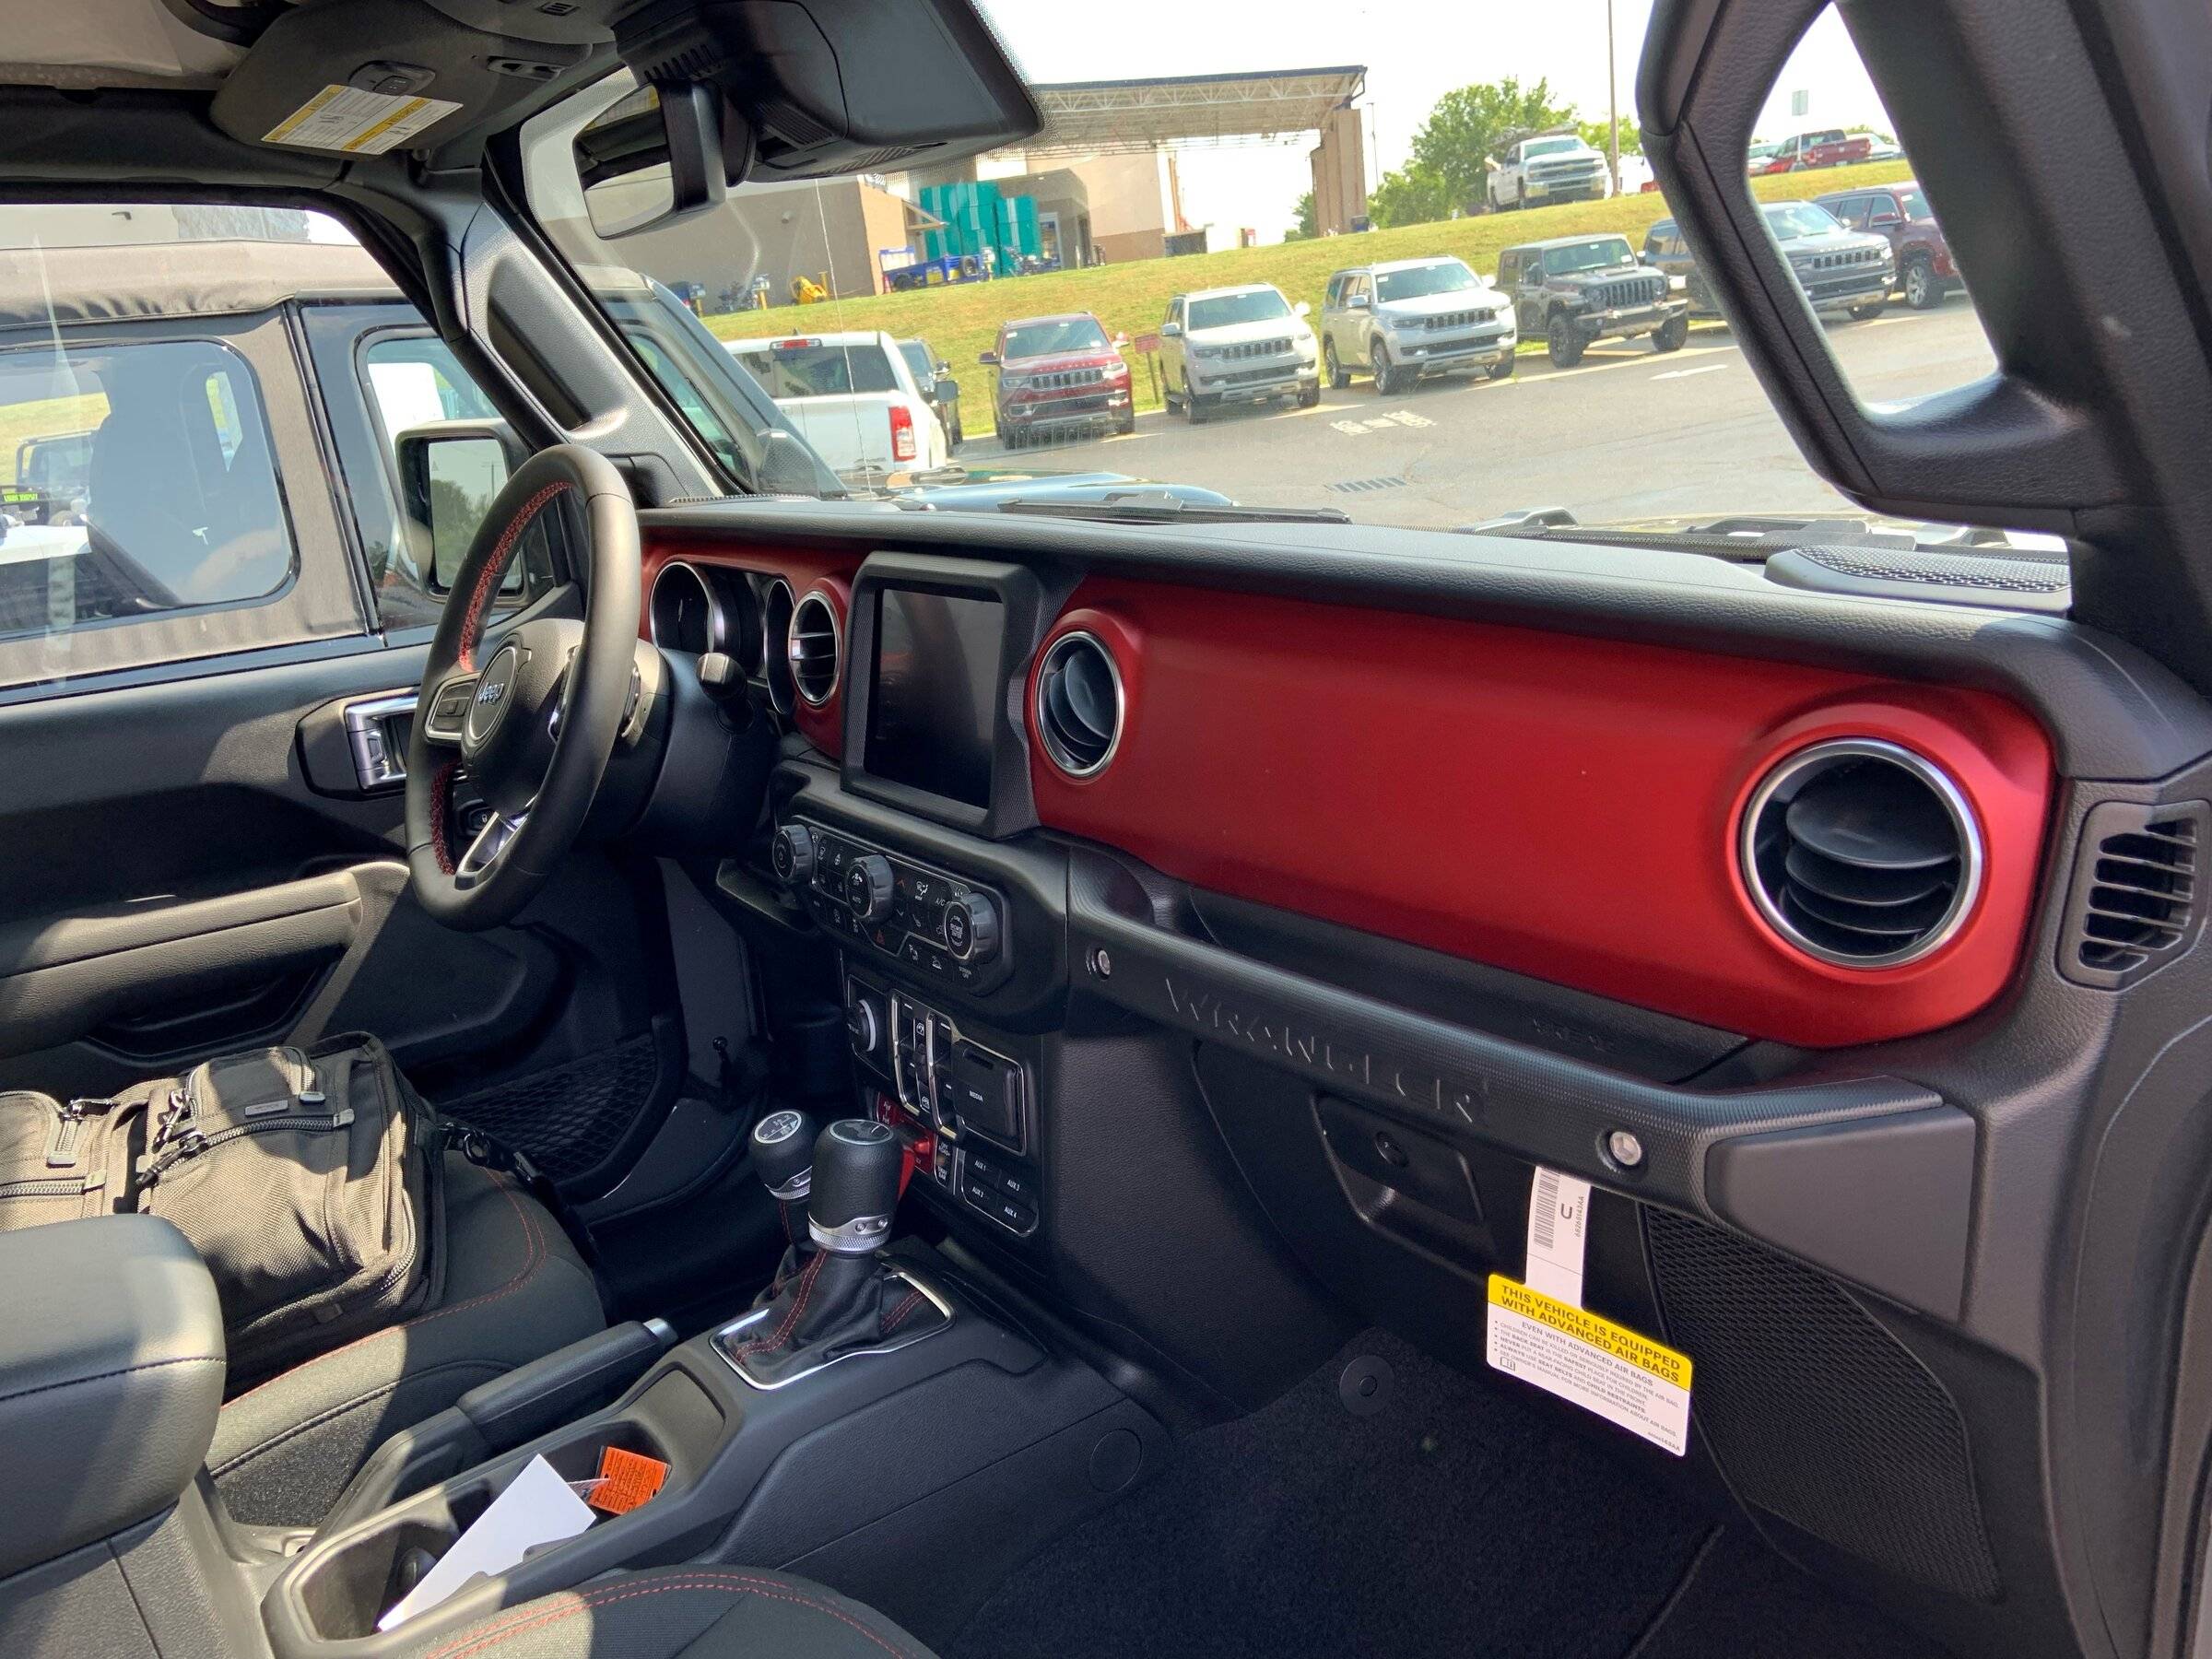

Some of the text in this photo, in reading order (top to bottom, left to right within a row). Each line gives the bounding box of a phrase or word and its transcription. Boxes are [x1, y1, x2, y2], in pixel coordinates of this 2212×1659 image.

[478, 682, 504, 702] Jeep
[935, 897, 946, 907] A/C
[974, 1159, 983, 1170] AUX
[971, 1185, 981, 1196] AUX
[1006, 1179, 1017, 1189] AUX
[1004, 1206, 1013, 1217] AUX
[1560, 1203, 1573, 1219] U
[1503, 1285, 1681, 1371] THIS VEHICLE IS EQUIPPED
[1500, 1336, 1520, 1347] NEVER
[1501, 1296, 1679, 1383] WITH ADVANCED AIR BAGS
[1512, 1334, 1528, 1345] BACK
[1530, 1341, 1544, 1351] SEAT
[1564, 1356, 1586, 1370] SAFEST
[1523, 1322, 1653, 1386] EVEN WITH ADVANCED AIR BAGS
[1500, 1343, 1525, 1358] ALWAYS
[1538, 1359, 1553, 1369] SEAT
[1555, 1366, 1572, 1378] BELTS
[1586, 1381, 1606, 1394] CHILD
